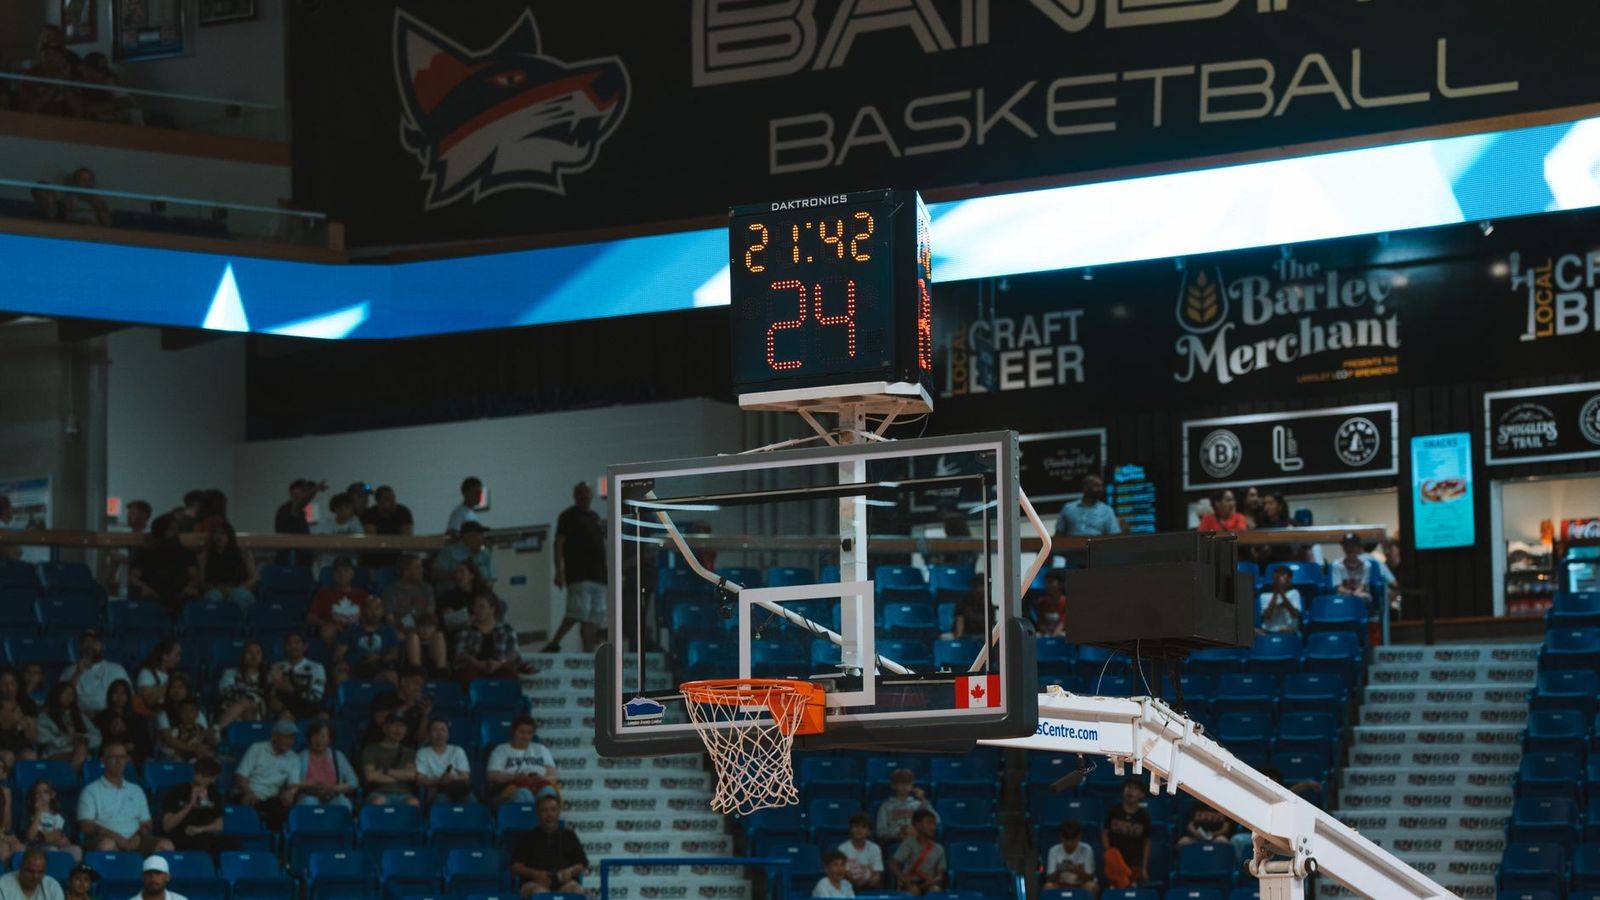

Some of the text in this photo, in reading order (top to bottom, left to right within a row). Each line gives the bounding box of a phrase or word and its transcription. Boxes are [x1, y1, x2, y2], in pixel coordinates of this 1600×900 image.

[768, 39, 1519, 174] BASKETBALL
[771, 195, 847, 211] DAKTRONICS
[746, 211, 873, 272] 21:42
[1228, 270, 1393, 326] Barley
[1273, 259, 1319, 281] The
[1536, 258, 1553, 337] LOCAL
[767, 280, 855, 370] 24
[969, 308, 1086, 351] CRAFT
[1556, 289, 1600, 335] B
[1174, 313, 1401, 385] Merchant
[1035, 721, 1098, 741] sCentre.com
